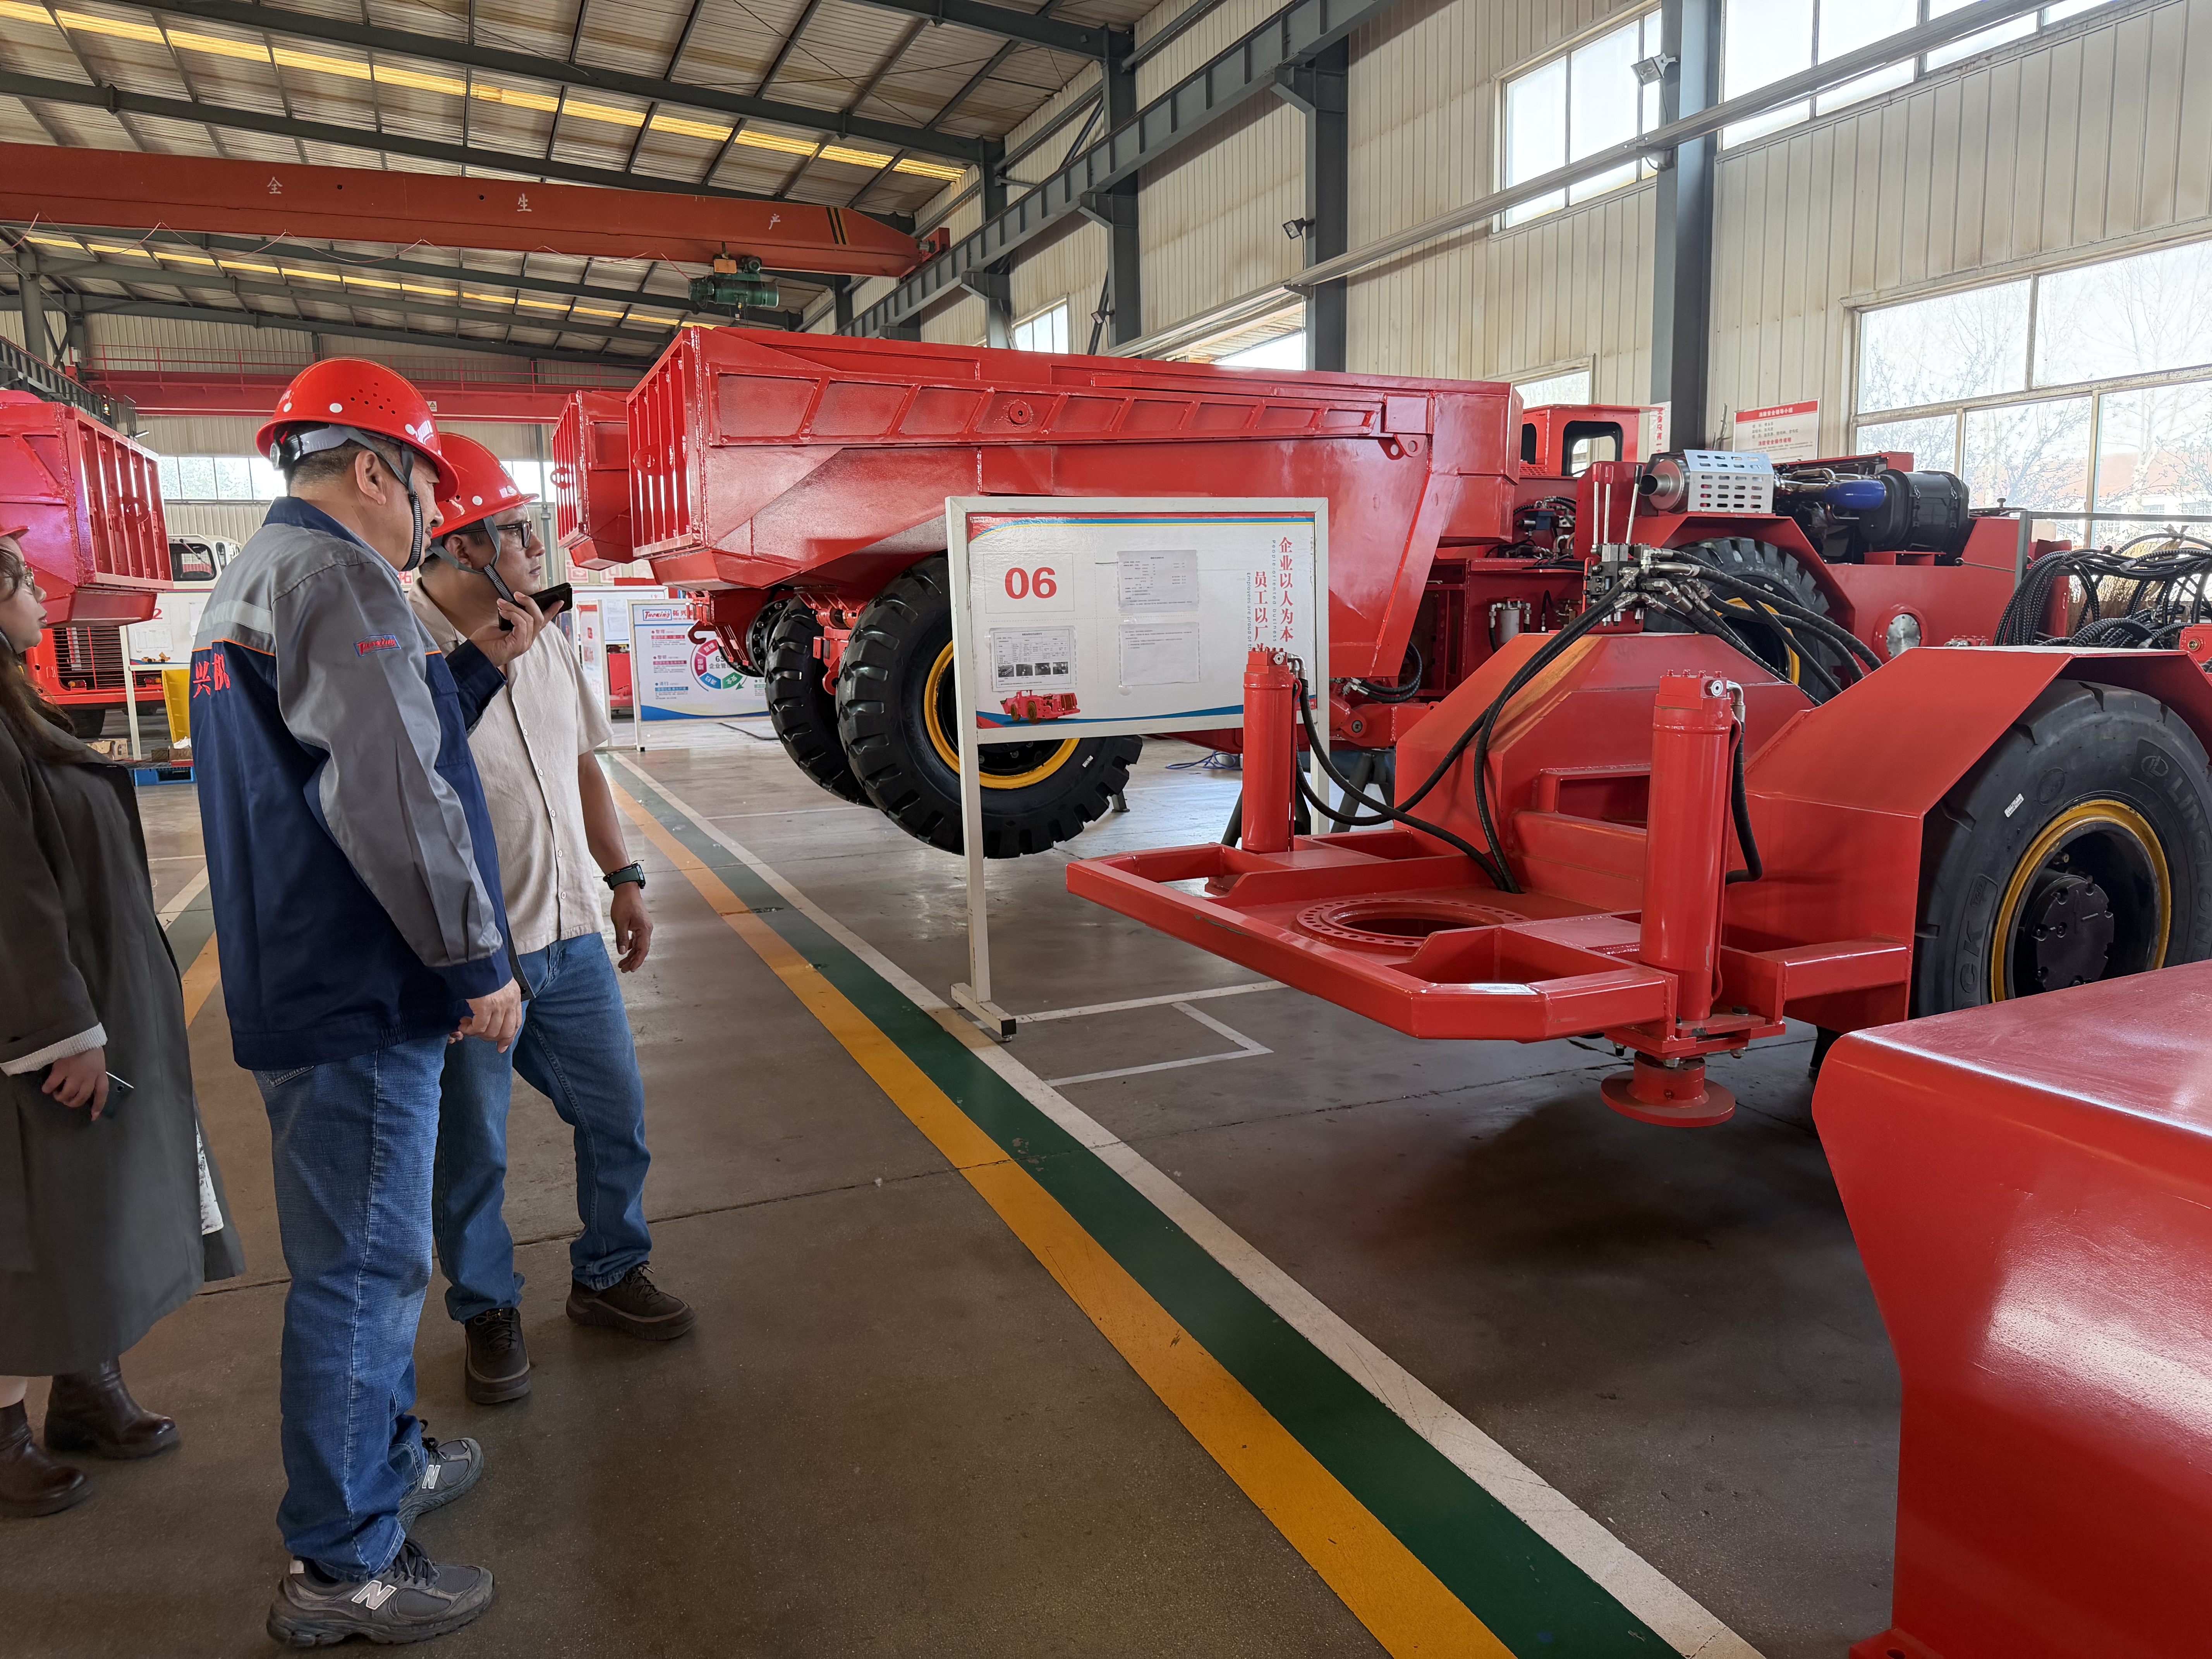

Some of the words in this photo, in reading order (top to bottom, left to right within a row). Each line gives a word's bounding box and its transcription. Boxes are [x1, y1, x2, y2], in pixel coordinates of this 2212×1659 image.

[267, 176, 283, 194] 全
[517, 193, 532, 212] 生
[769, 213, 781, 230] 产
[1005, 567, 1057, 599] 06
[1279, 537, 1293, 642] 企业以人为本
[422, 1465, 440, 1489] N
[351, 1580, 397, 1610] N
